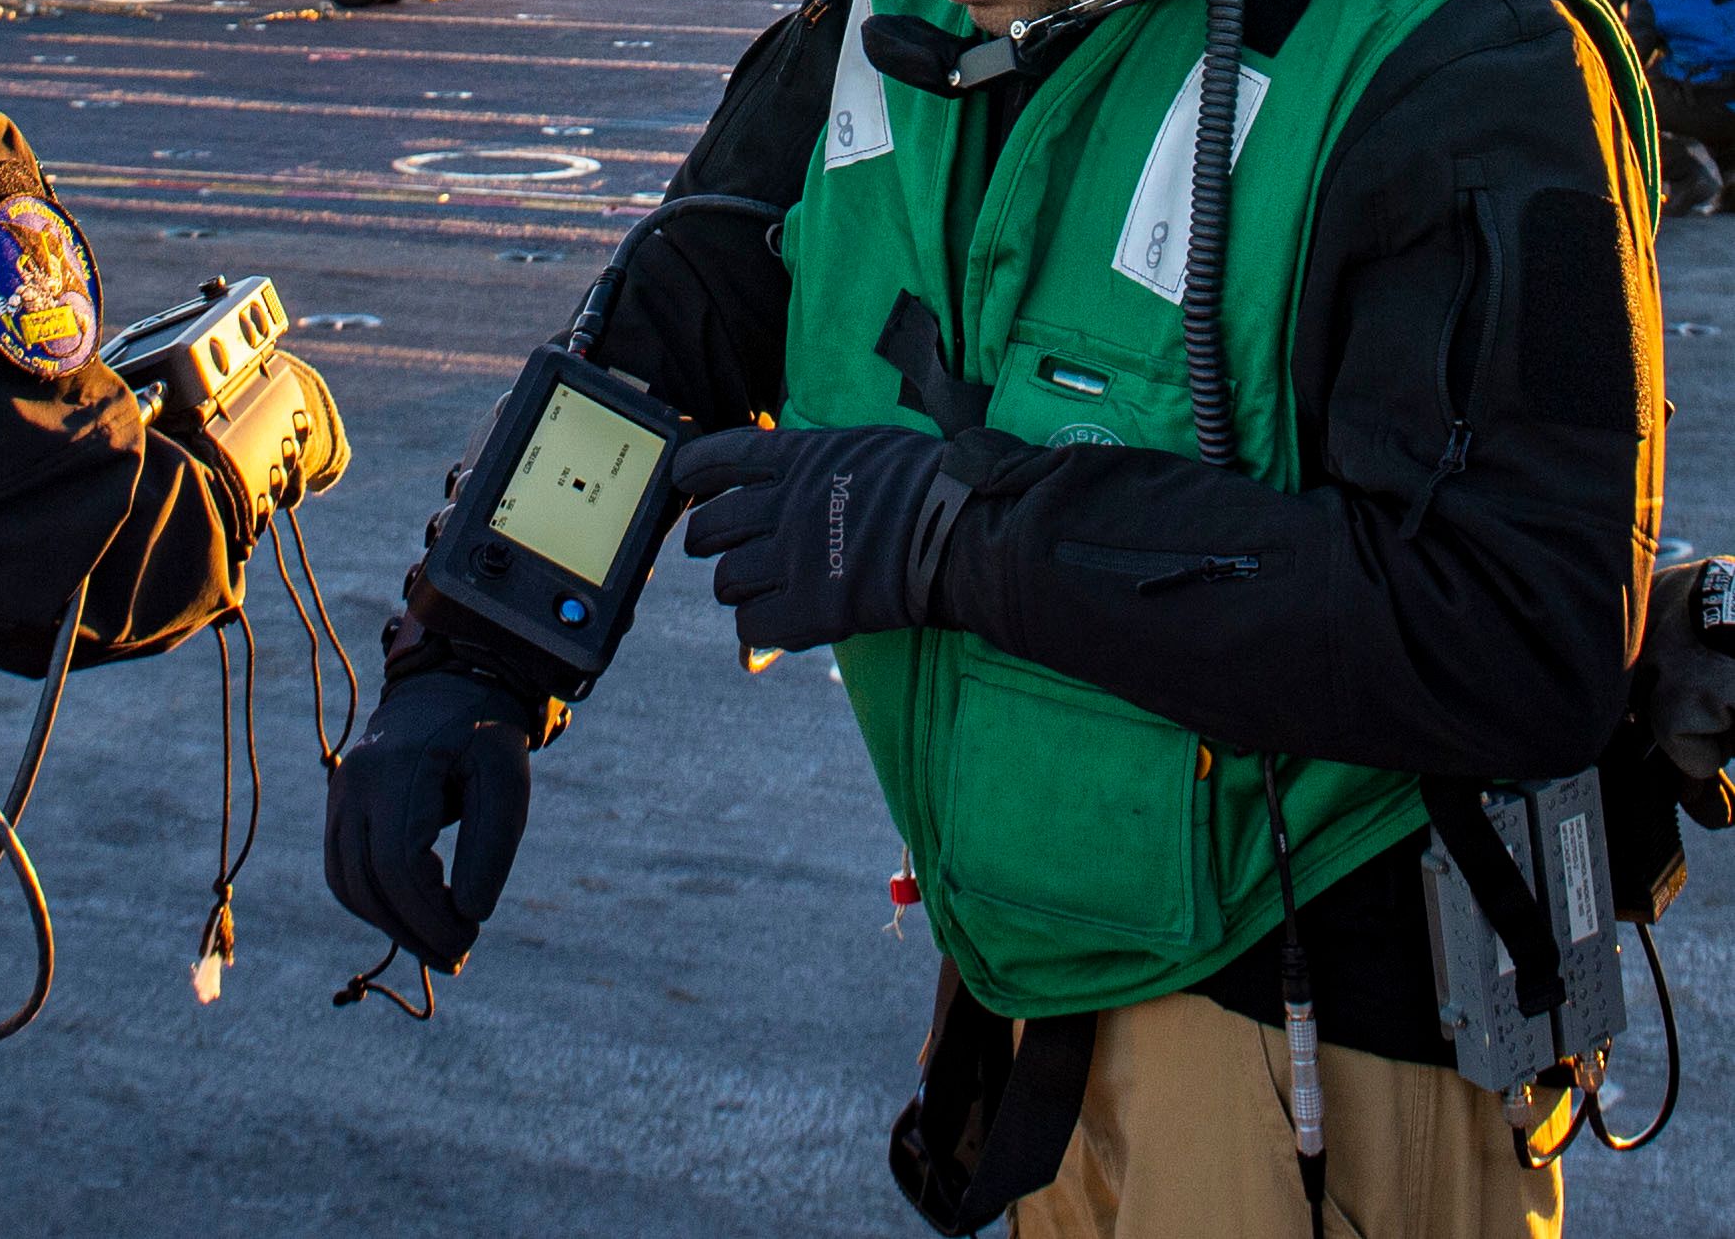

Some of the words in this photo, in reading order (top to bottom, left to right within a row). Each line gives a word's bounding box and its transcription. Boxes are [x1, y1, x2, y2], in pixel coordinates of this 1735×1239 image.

[522, 444, 542, 475] CONTROL
[587, 482, 602, 505] SETUP
[829, 472, 853, 580] Marmot
